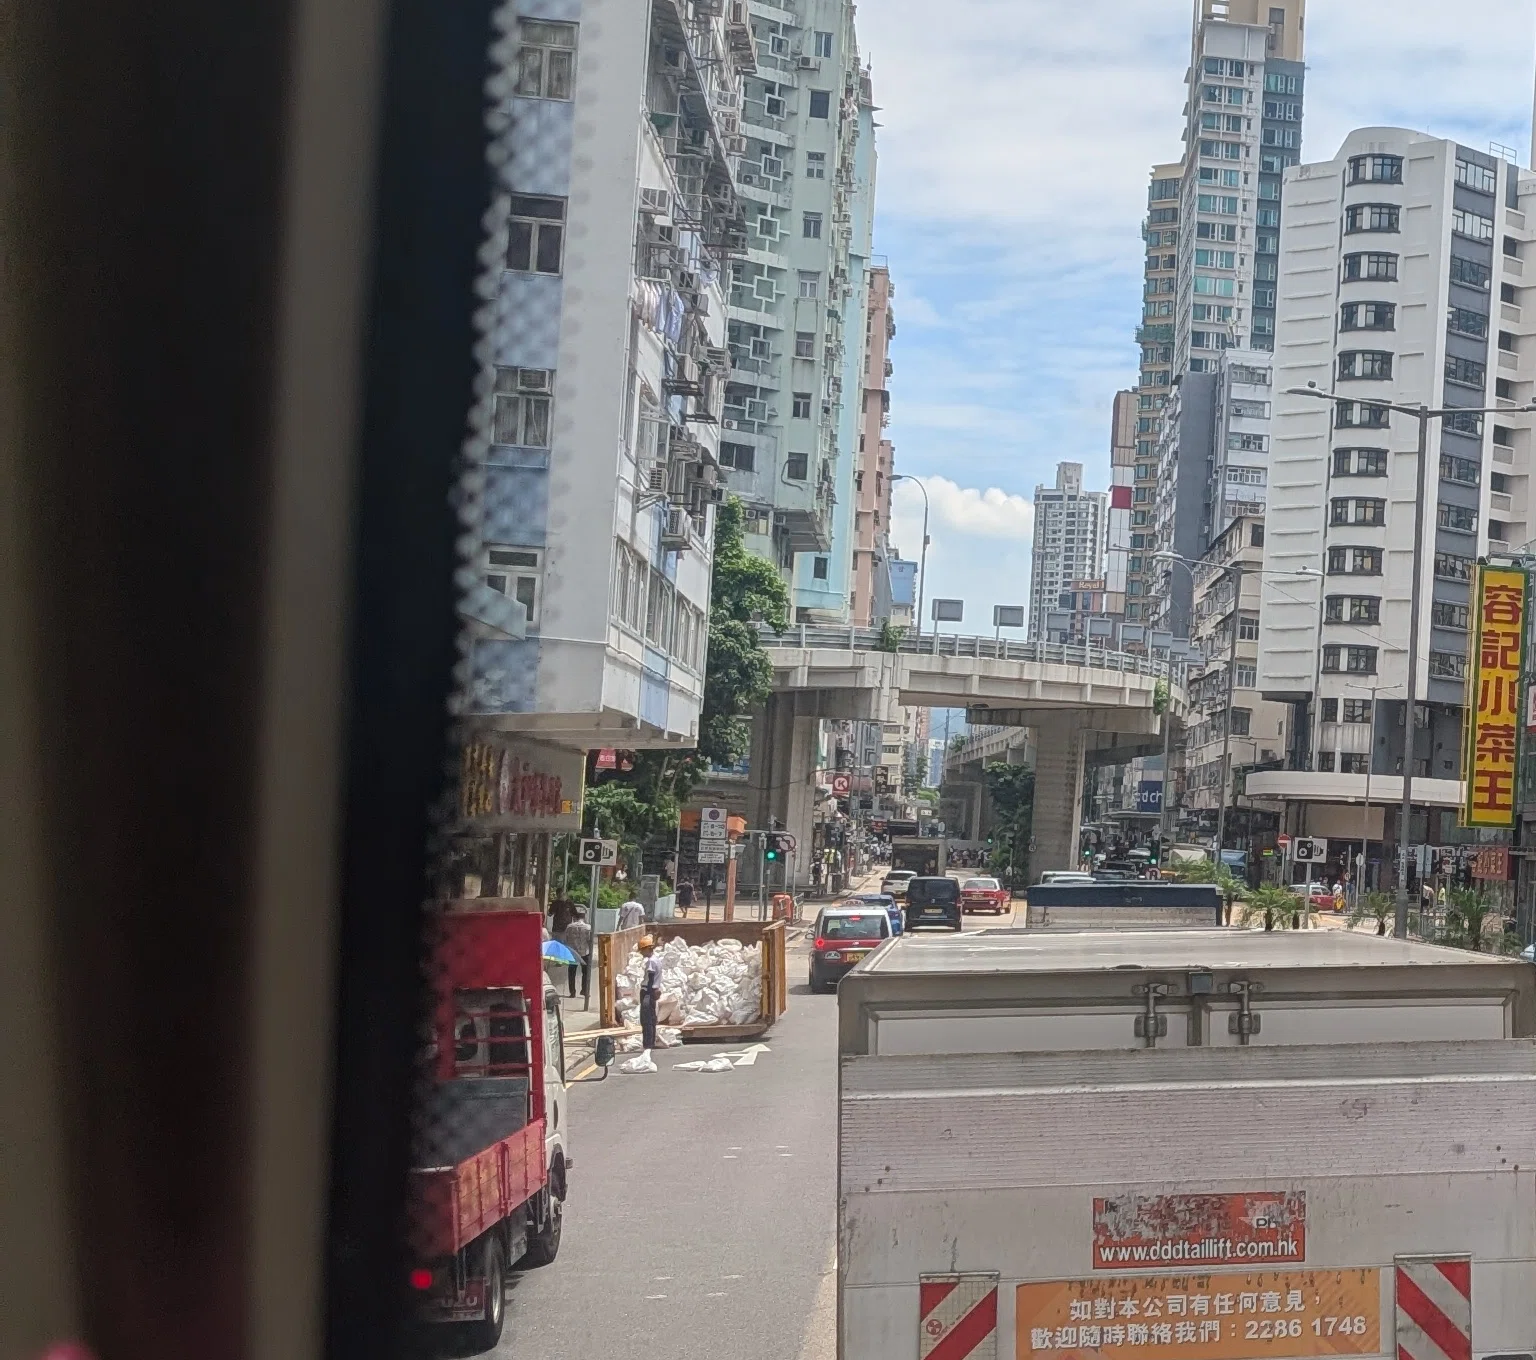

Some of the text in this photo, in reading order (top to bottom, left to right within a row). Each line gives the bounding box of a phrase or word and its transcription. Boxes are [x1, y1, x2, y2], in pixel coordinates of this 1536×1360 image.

[1473, 584, 1523, 811] 容記小菜王
[1100, 1238, 1298, 1262] www.dddtaillift.com.hk
[1245, 1318, 1303, 1340] 2286
[1311, 1315, 1367, 1336] 1748
